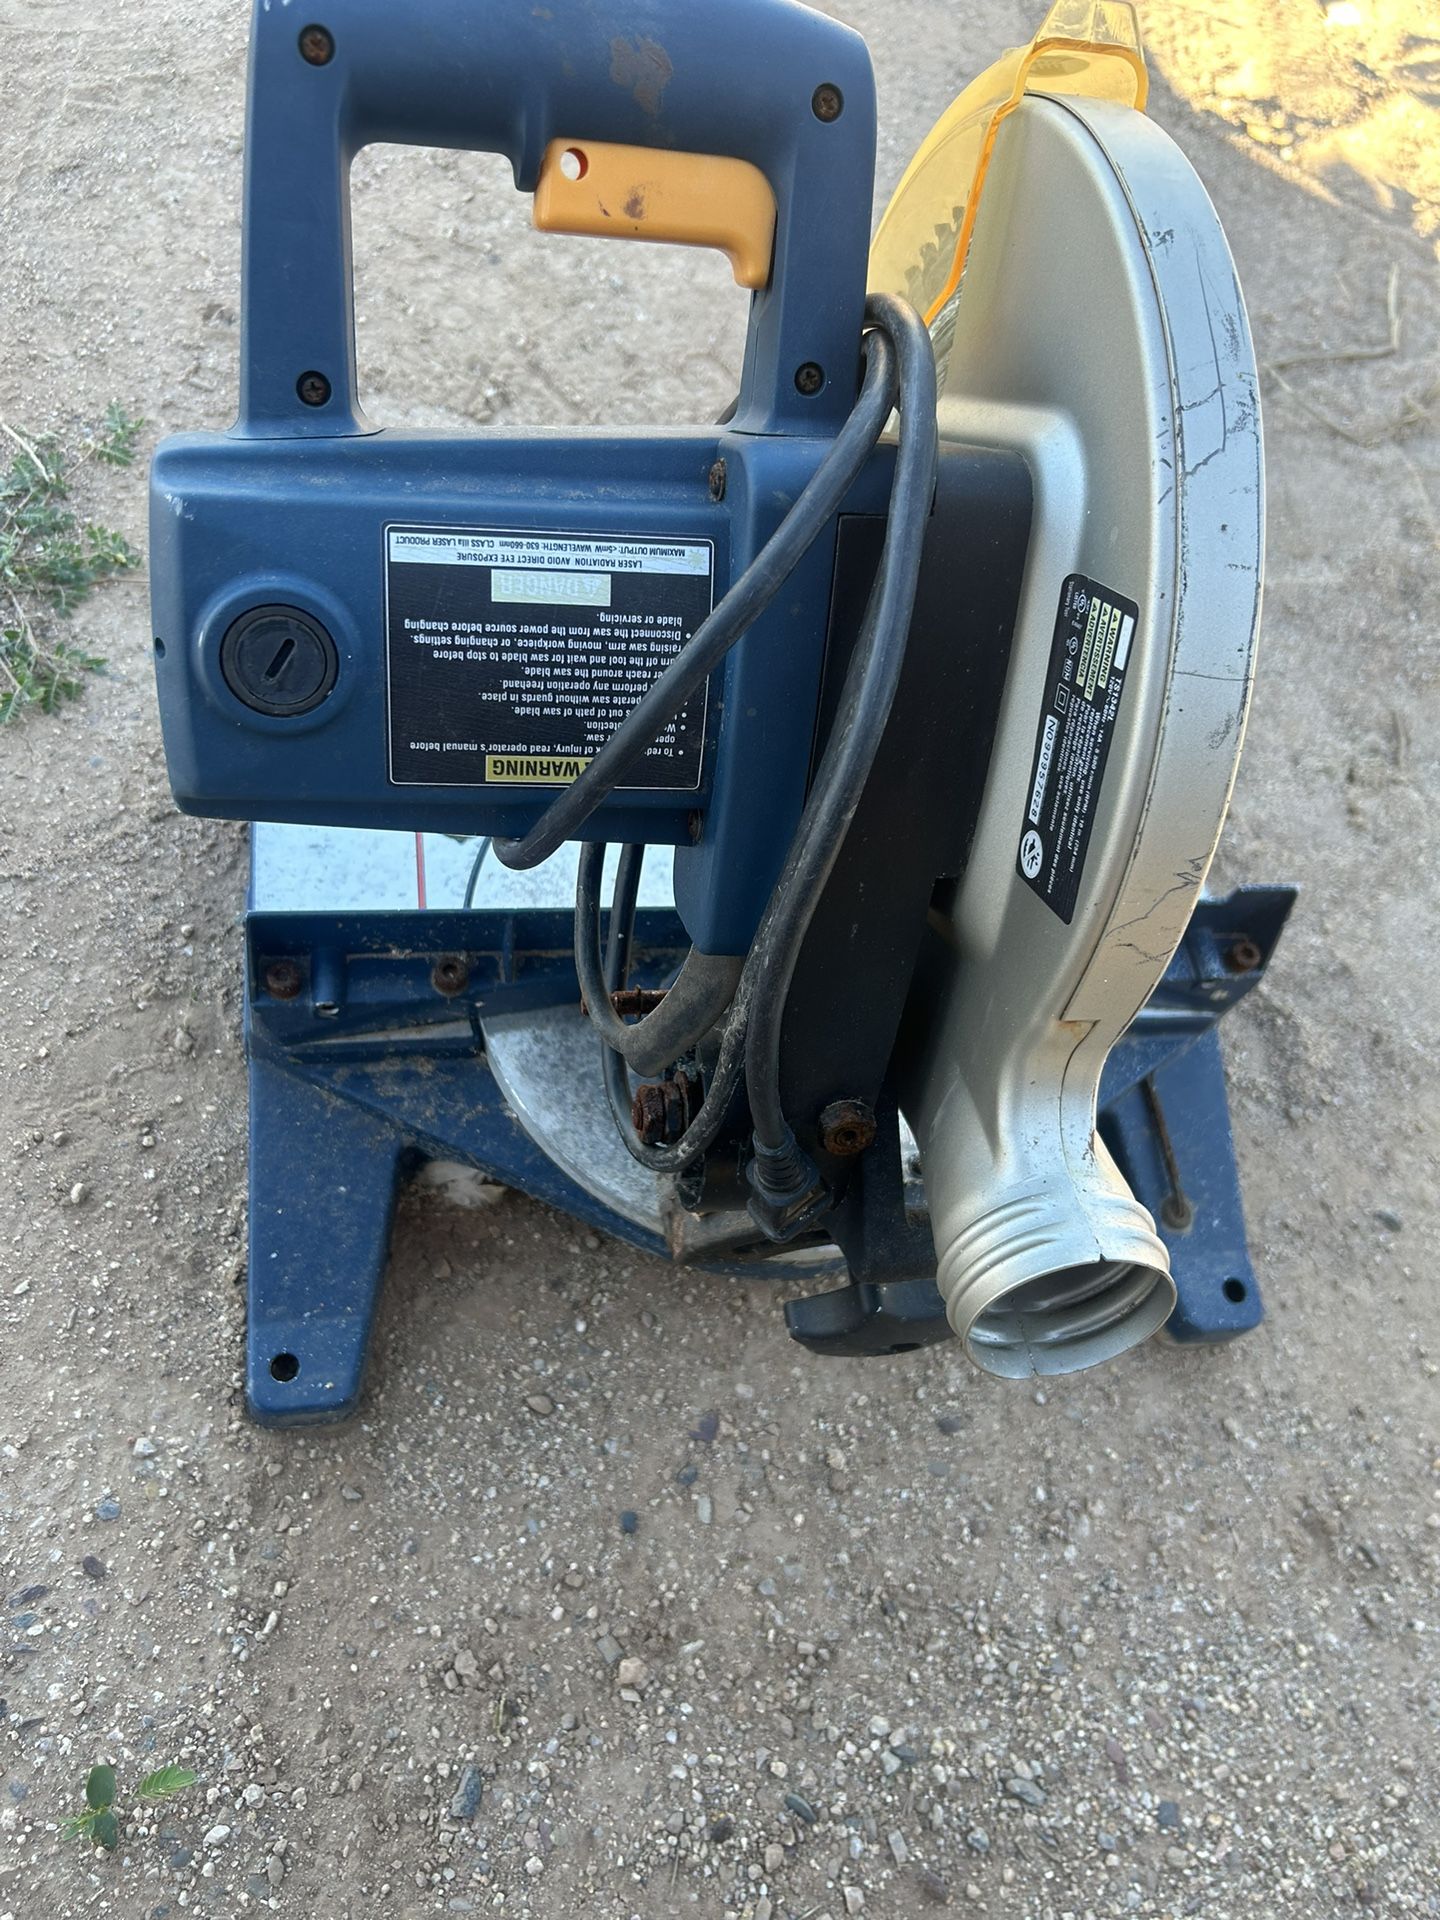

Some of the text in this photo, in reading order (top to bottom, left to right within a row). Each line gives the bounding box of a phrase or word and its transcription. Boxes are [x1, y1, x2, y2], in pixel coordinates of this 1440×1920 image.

[396, 536, 430, 545] PRODUCT
[432, 538, 456, 546] LASER
[471, 539, 494, 548] CLASS
[543, 543, 592, 552] WAVELENGTH:
[595, 545, 617, 553] <5mW
[618, 546, 648, 555] OUTPUT:
[649, 547, 685, 557] MAXIMUM
[457, 552, 642, 568] LASER RADIATION AVOID DIRECT EYE EXPOSURE
[499, 575, 580, 596] DANGER
[597, 612, 642, 624] servicing.
[657, 616, 682, 627] blade
[404, 619, 681, 640] Disconnect the saw from the power source before changing
[410, 633, 452, 646] settings.
[455, 635, 498, 648] changing
[514, 638, 565, 650] workpiece,
[568, 639, 601, 651] moving
[605, 641, 626, 650] arm,
[650, 642, 682, 654] raising
[1079, 615, 1095, 677] ADVERTENCIA
[433, 650, 463, 661] before
[467, 650, 487, 661] stop
[490, 652, 498, 661] to
[502, 652, 527, 663] blade
[551, 654, 564, 664] for
[567, 655, 586, 664] wait
[590, 655, 606, 665] and
[1087, 619, 1106, 696] AVERTISSEMENT
[1100, 628, 1116, 682] WARNING
[609, 656, 626, 666] tool
[629, 657, 643, 666] the
[646, 657, 658, 667] off
[521, 667, 550, 677] blade.
[574, 668, 588, 678] the
[592, 669, 623, 678] around
[626, 670, 651, 680] reach
[500, 680, 544, 690] freehand.
[547, 680, 590, 691] operation
[593, 681, 609, 690] any
[612, 682, 648, 693] perform
[478, 692, 507, 702] place.
[510, 694, 518, 702] in
[522, 693, 553, 703] guards
[556, 695, 589, 704] without
[613, 695, 641, 705] perate
[1108, 679, 1121, 721] TS1342L
[511, 706, 540, 716] blade.
[564, 708, 572, 717] of
[575, 707, 595, 717] path
[597, 709, 606, 718] of
[609, 709, 623, 718] out
[584, 722, 623, 730] otection.
[1092, 712, 1100, 735] When
[1080, 707, 1095, 760] replacement
[410, 742, 440, 751] before
[443, 743, 477, 751] manual
[480, 743, 527, 752] operator's
[530, 745, 550, 753] read
[554, 744, 582, 754] injury,
[584, 746, 593, 754] of
[644, 748, 661, 756] red
[664, 748, 673, 757] To
[493, 760, 580, 776] WARNING
[1074, 794, 1082, 814] only
[1067, 814, 1078, 850] identical
